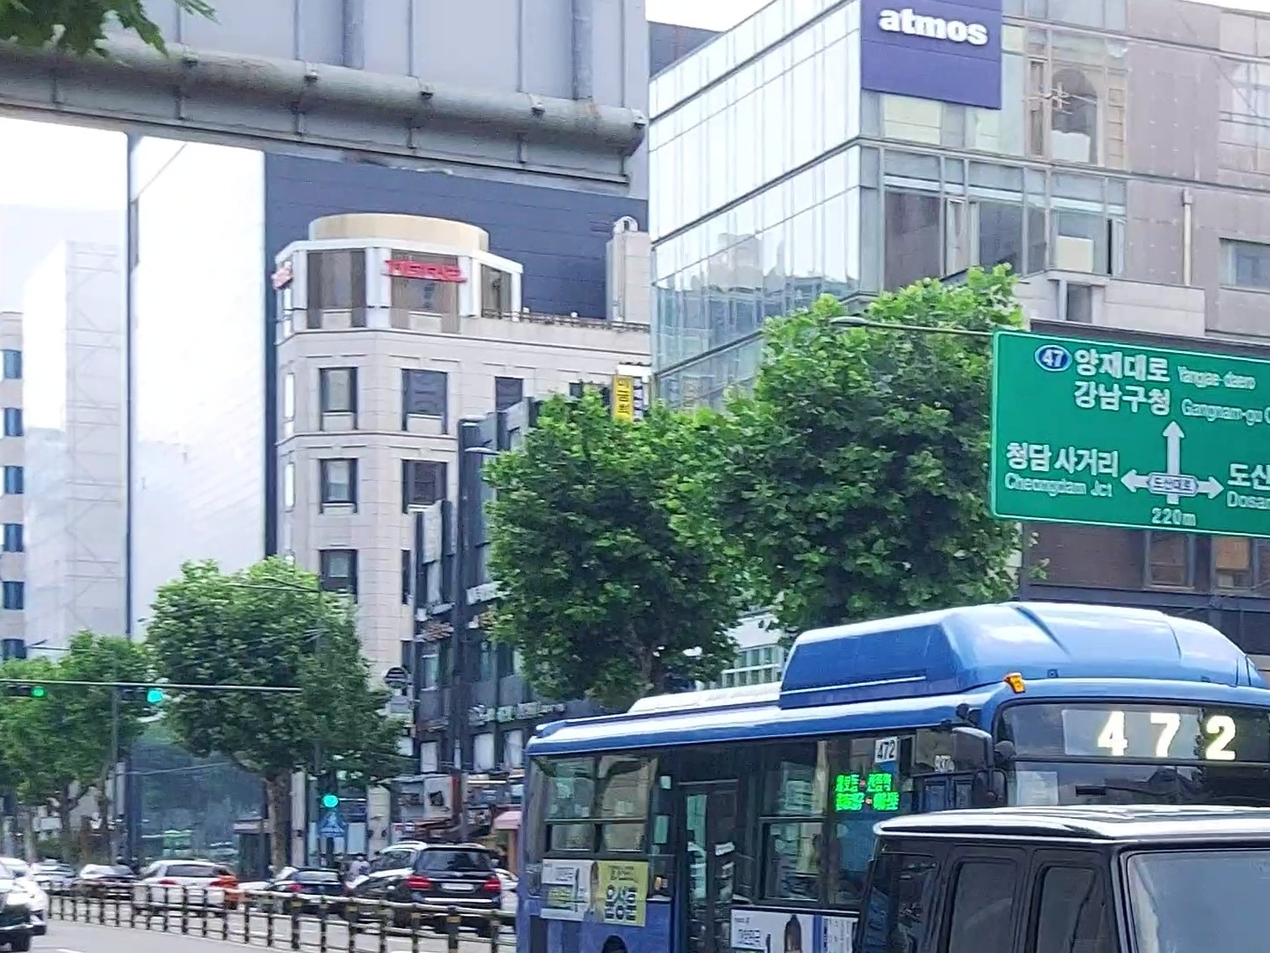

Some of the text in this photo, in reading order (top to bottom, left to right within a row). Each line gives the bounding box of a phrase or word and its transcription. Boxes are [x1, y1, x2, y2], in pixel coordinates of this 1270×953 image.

[879, 8, 988, 46] atmos
[1041, 349, 1064, 368] 47
[1074, 348, 1170, 382] 양재대로
[1073, 380, 1171, 417] 강남구청
[1181, 398, 1263, 426] Gangnam-gu
[1005, 442, 1119, 478] 청담 사거리
[1003, 473, 1087, 497] Cheongdam
[1151, 507, 1197, 527] 220m
[876, 740, 896, 760] 472
